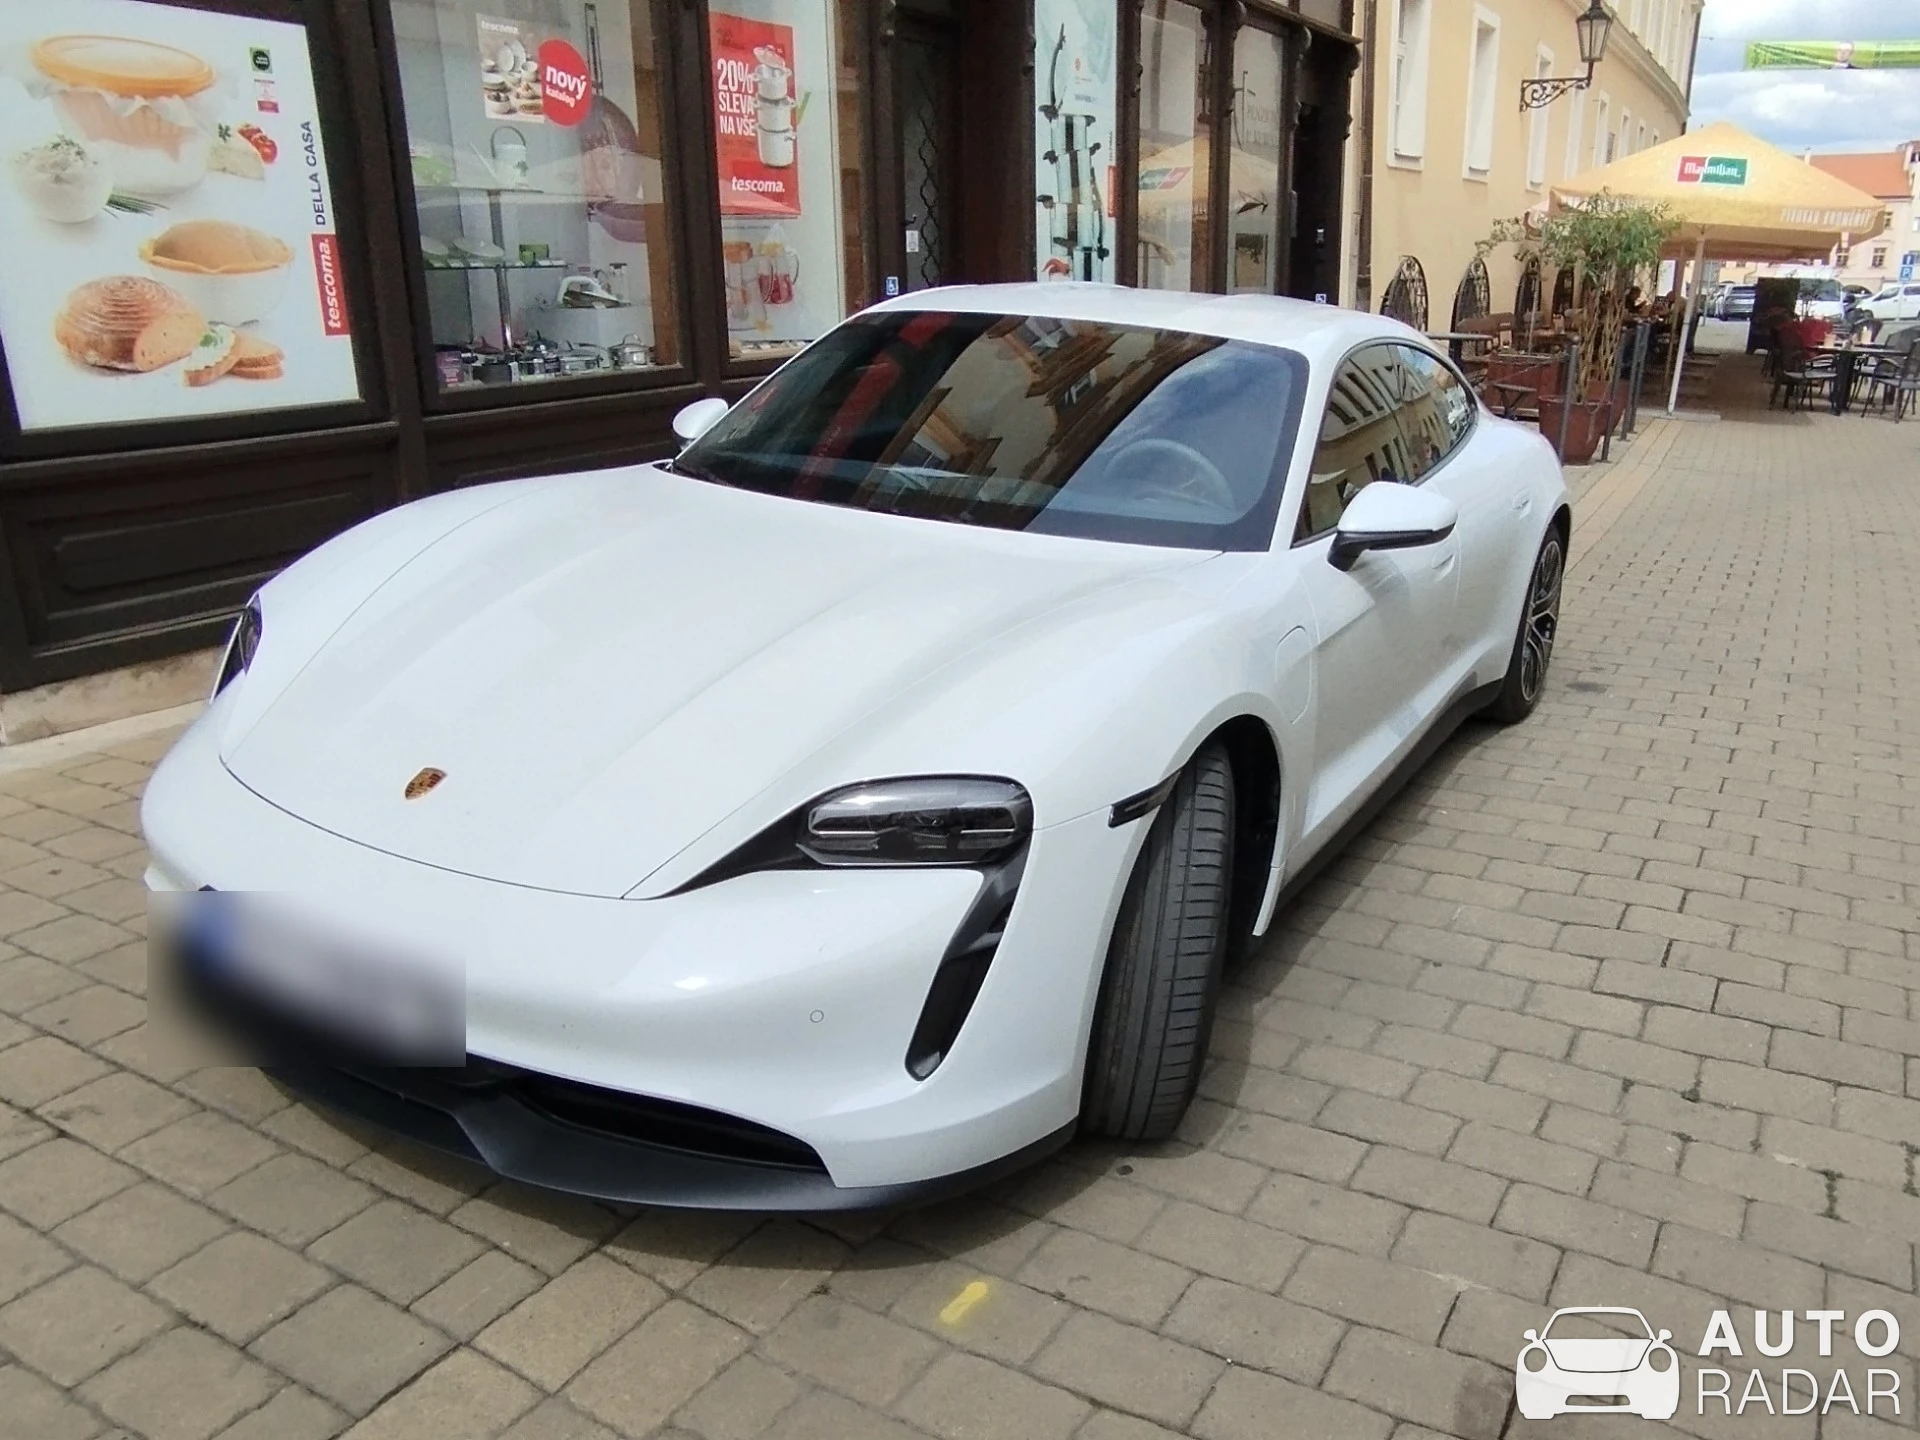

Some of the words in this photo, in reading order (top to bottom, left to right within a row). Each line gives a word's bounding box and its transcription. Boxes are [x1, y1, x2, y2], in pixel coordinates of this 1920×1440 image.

[546, 65, 587, 100] nový
[717, 58, 754, 95] 20%
[718, 92, 756, 116] SLEVA
[720, 115, 735, 134] NA
[736, 113, 757, 137] VŠE
[301, 121, 317, 166] CASA
[309, 172, 326, 225] DELLA
[731, 176, 786, 193] tescoma.
[319, 238, 342, 329] tescoma.
